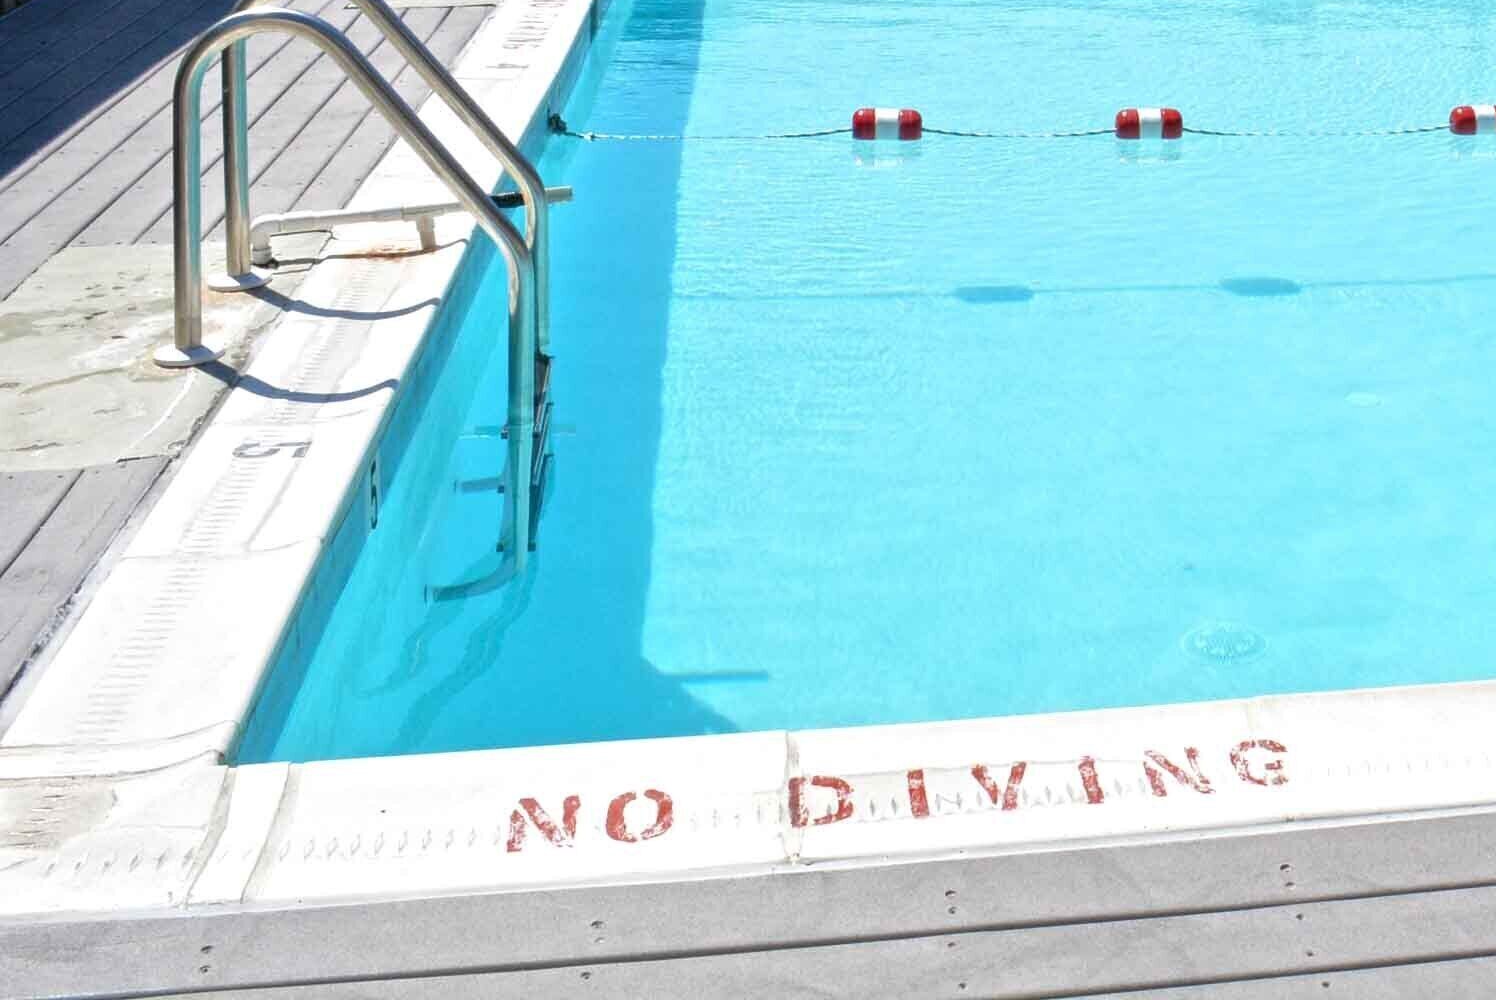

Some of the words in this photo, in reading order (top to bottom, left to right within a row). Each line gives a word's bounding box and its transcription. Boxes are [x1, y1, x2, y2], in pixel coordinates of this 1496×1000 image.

[232, 441, 312, 458] 5
[506, 788, 675, 852] NO
[789, 739, 1289, 828] DIVING
